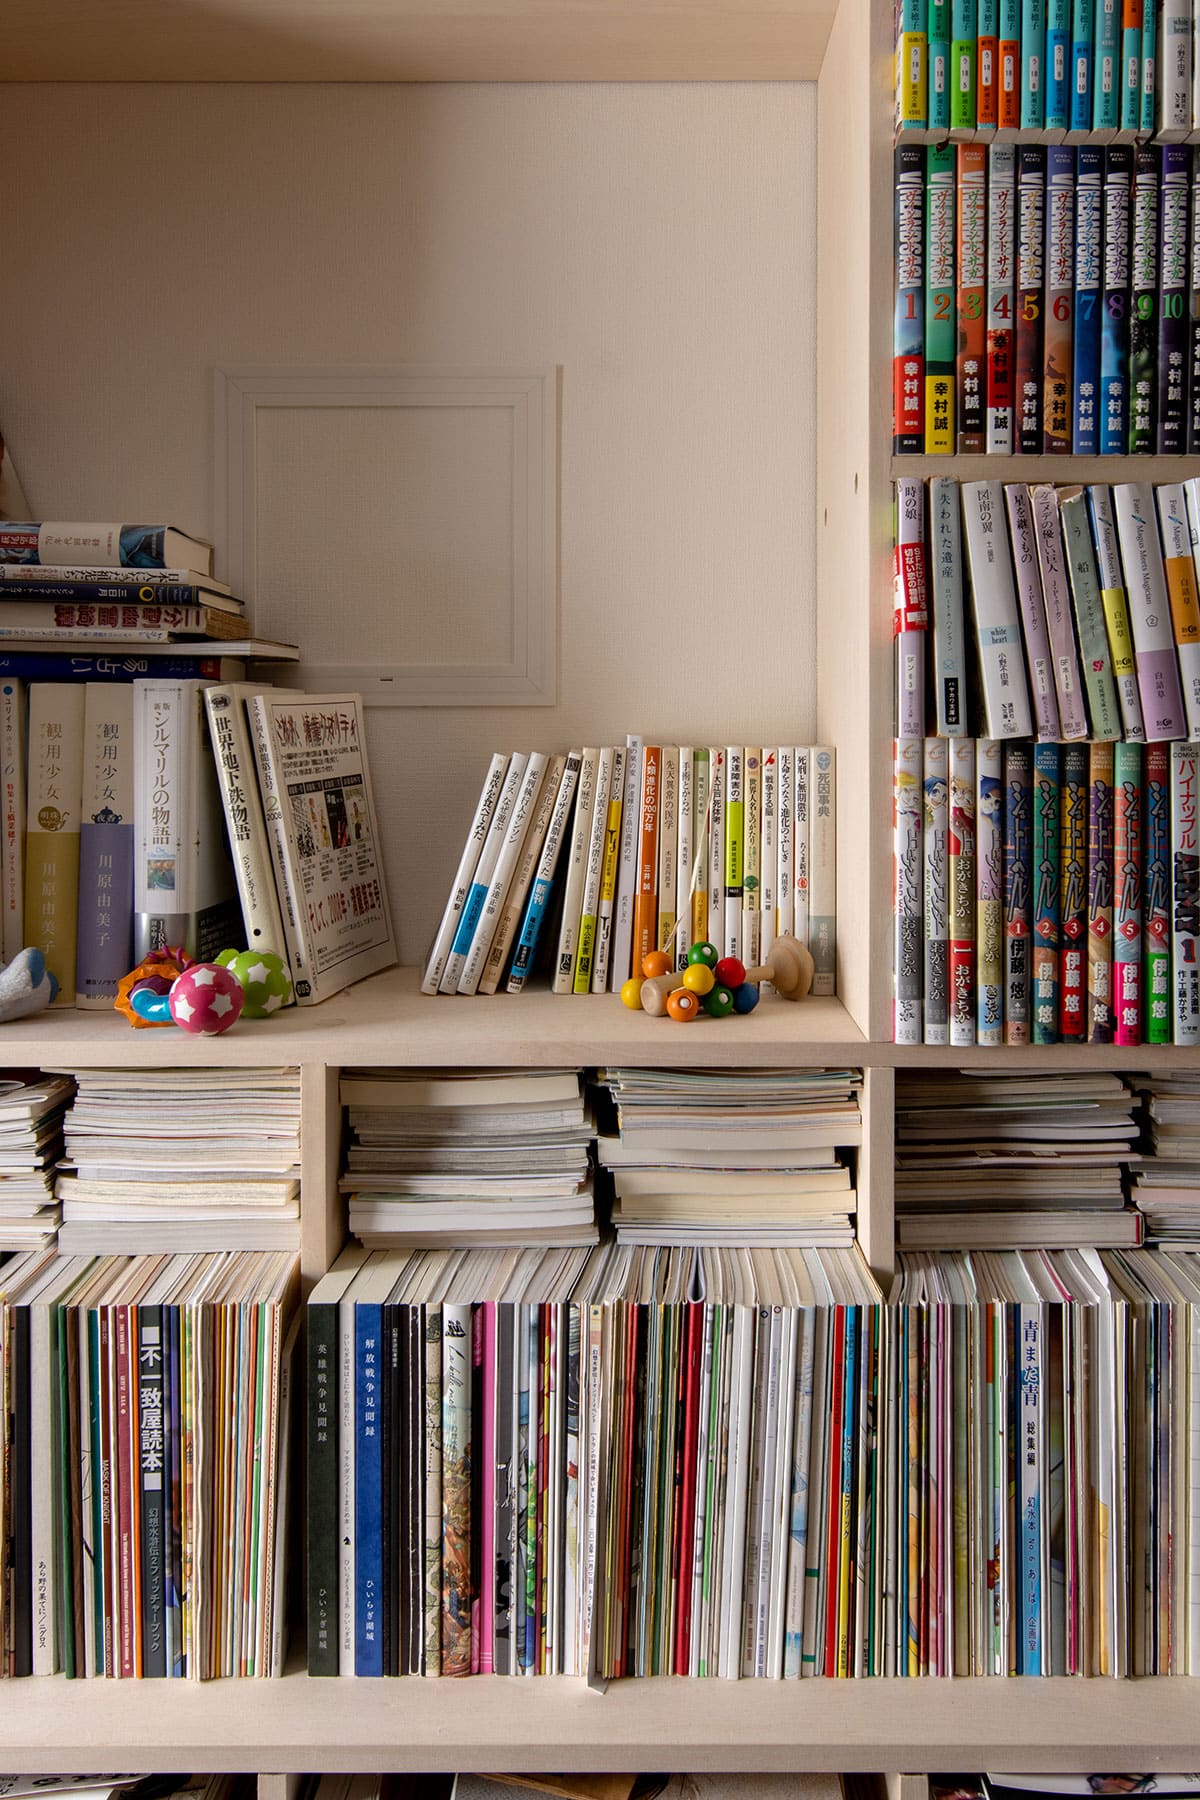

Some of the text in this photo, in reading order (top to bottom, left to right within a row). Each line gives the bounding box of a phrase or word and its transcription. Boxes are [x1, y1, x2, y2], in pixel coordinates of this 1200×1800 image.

[905, 294, 918, 319] 1
[933, 294, 950, 319] 2
[965, 295, 981, 319] 3
[993, 295, 1011, 319] 4
[1022, 296, 1039, 320] 5
[1053, 295, 1069, 321] 6
[1080, 295, 1097, 321] 7
[1137, 295, 1152, 320] 9
[1163, 294, 1183, 319] 10
[905, 487, 917, 519] 時の娘
[940, 494, 953, 578] 失われた遺産
[1136, 525, 1144, 548] Magus
[64, 569, 179, 583] 日本人になった祖先たち
[1140, 549, 1148, 572] Meets
[98, 588, 127, 597] 三日月
[1143, 572, 1152, 605] Magician
[54, 604, 199, 628] 三分割幽霊綺譚
[71, 657, 147, 674] 易占い
[153, 703, 170, 711] 新版
[46, 722, 62, 800] 観用少女
[102, 722, 119, 801] 観用少女
[152, 711, 171, 845] シルマリルの物語
[215, 717, 253, 841] 世界地下鉄物語
[507, 771, 519, 794] カラス
[581, 760, 594, 811] 医学の歴史
[644, 756, 656, 832] 人類進化の700万年
[797, 756, 807, 822] 死刑と無期懲役
[509, 770, 539, 843] 死刑執行人サンソン
[664, 760, 674, 829] 先天異常の医学
[765, 775, 773, 816] 戦争する脳
[781, 755, 790, 862] 生命をつなぐ進化のふしぎ
[818, 773, 830, 817] 死因事典
[1179, 760, 1196, 849] パイナップル
[748, 778, 756, 845] 世界人名ものがたり
[42, 863, 56, 954] 川原由美子
[97, 854, 113, 947] 川原由美子
[1016, 922, 1020, 934] 1
[1043, 922, 1050, 933] 2
[1070, 922, 1078, 933] 3
[1097, 921, 1104, 932] 4
[1126, 924, 1134, 935] 5
[1155, 922, 1162, 933] 9
[902, 918, 916, 976] おがきちか
[930, 942, 945, 1000] おがきちか
[955, 964, 970, 1024] おがきちか
[1023, 1320, 1039, 1407] 青また青
[364, 1339, 375, 1438] 解放戦争見聞録
[140, 1346, 163, 1472] 不一致屋読本
[102, 1483, 109, 1494] OF
[1028, 1497, 1036, 1530] 幻水本
